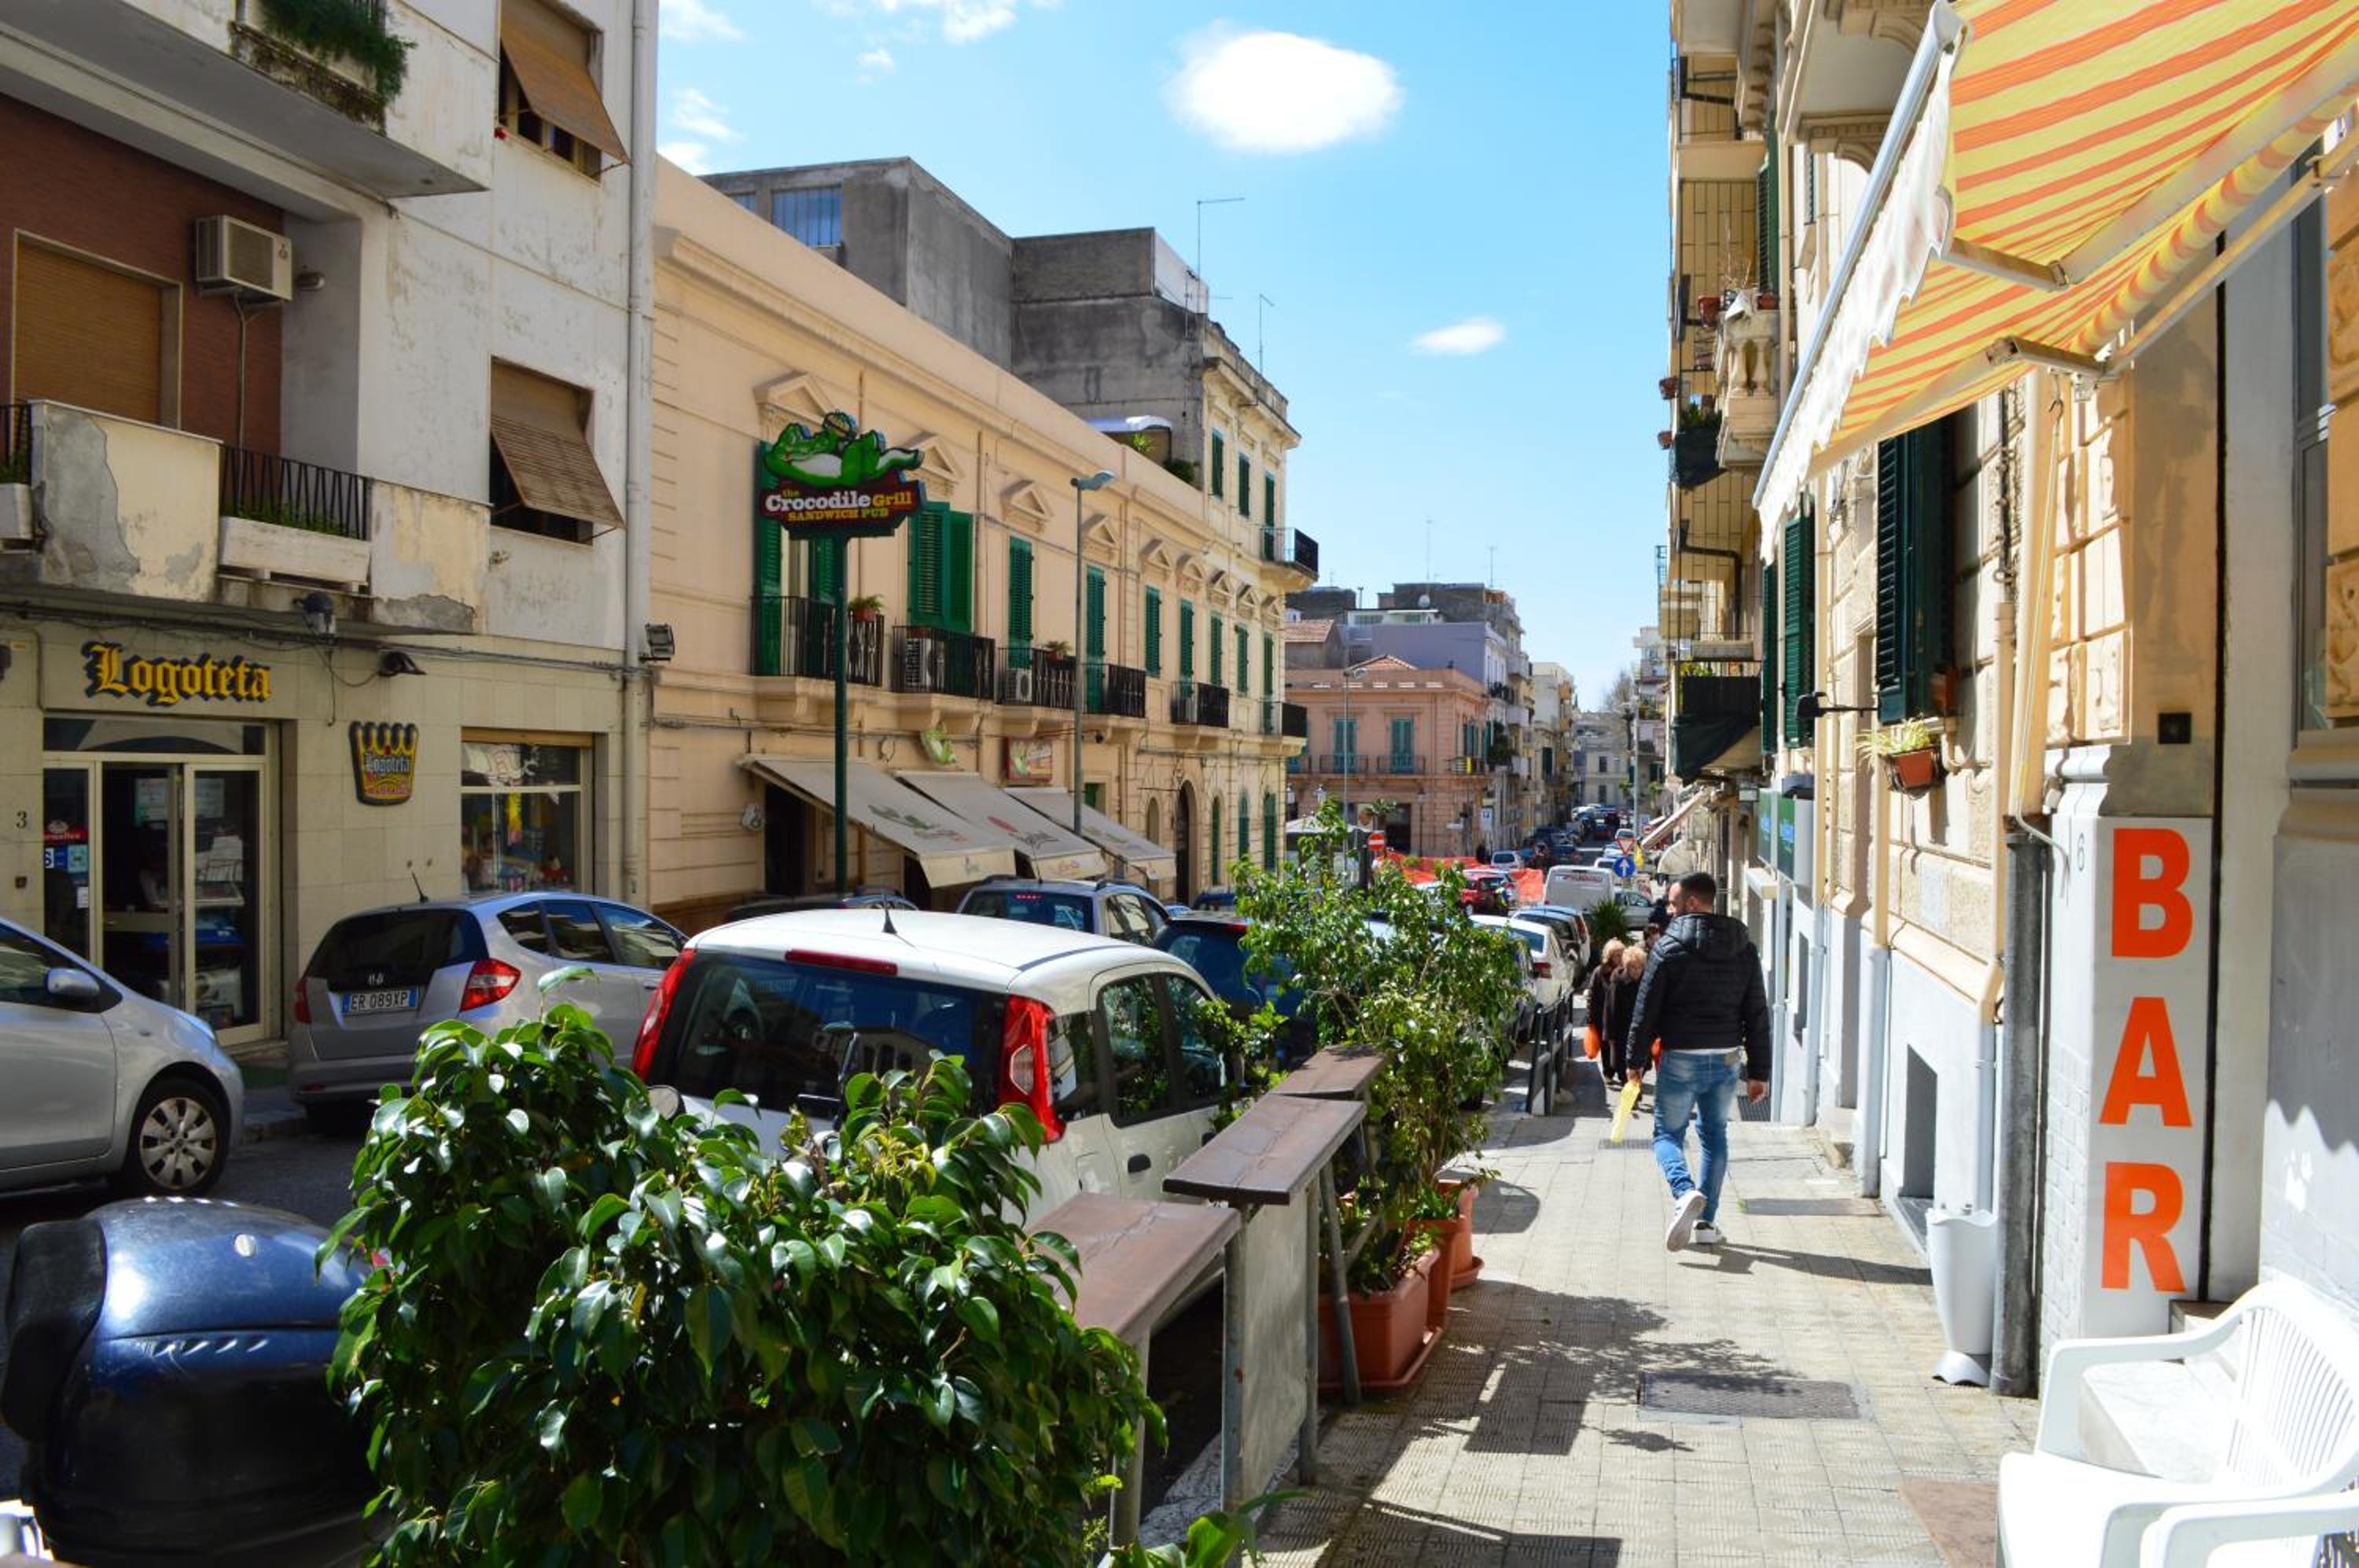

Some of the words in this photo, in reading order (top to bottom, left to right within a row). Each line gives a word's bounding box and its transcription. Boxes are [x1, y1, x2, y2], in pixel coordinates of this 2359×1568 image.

[765, 490, 870, 512] Crocodile
[872, 491, 912, 507] Grill
[788, 510, 859, 521] SANDWICH
[861, 508, 889, 519] PUB
[82, 642, 273, 706] Logoteta
[16, 811, 28, 830] 3
[2077, 832, 2085, 873] 6
[351, 994, 366, 1010] ER
[2099, 827, 2193, 1293] BAR
